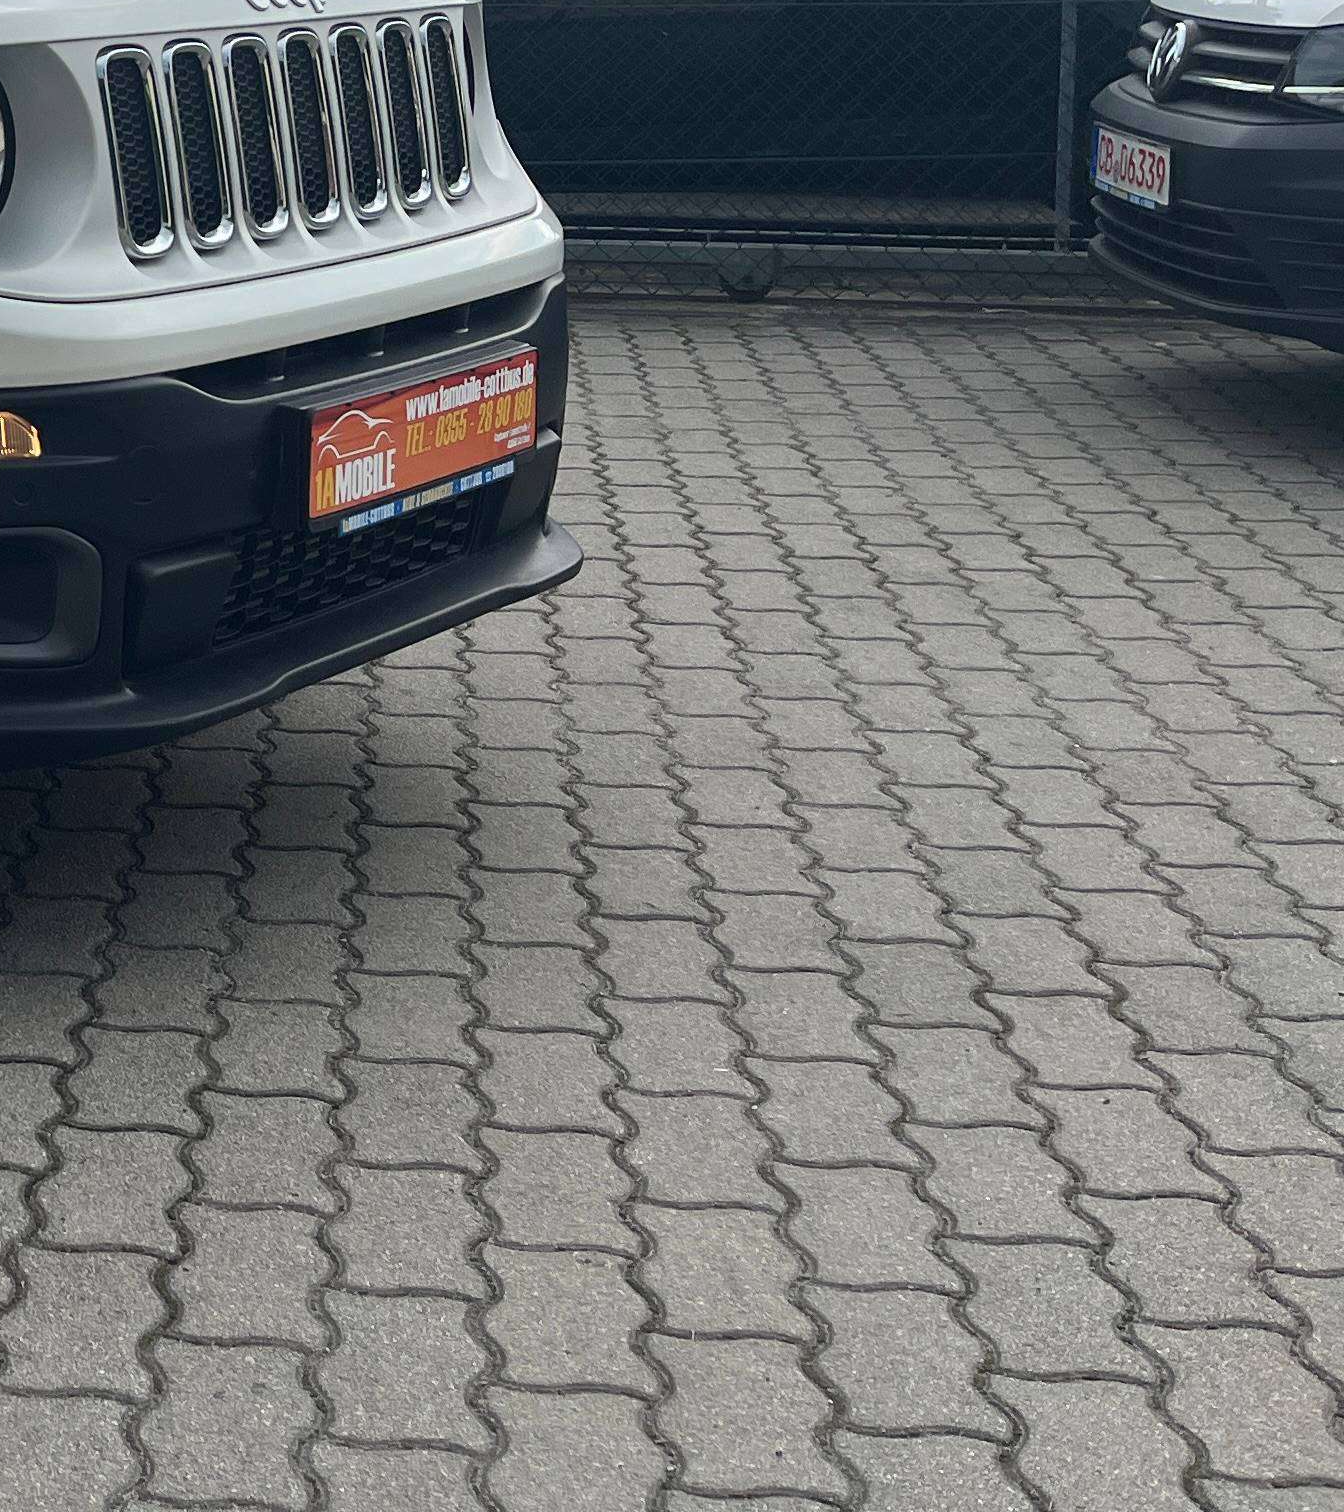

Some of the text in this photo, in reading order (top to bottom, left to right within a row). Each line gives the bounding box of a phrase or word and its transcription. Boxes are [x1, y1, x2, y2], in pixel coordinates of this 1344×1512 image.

[1119, 144, 1166, 194] 06339
[435, 408, 469, 448] 0355
[476, 399, 494, 434] 28
[495, 394, 511, 429] 90
[513, 387, 533, 422] 180
[315, 448, 397, 510] 1AMOBILE
